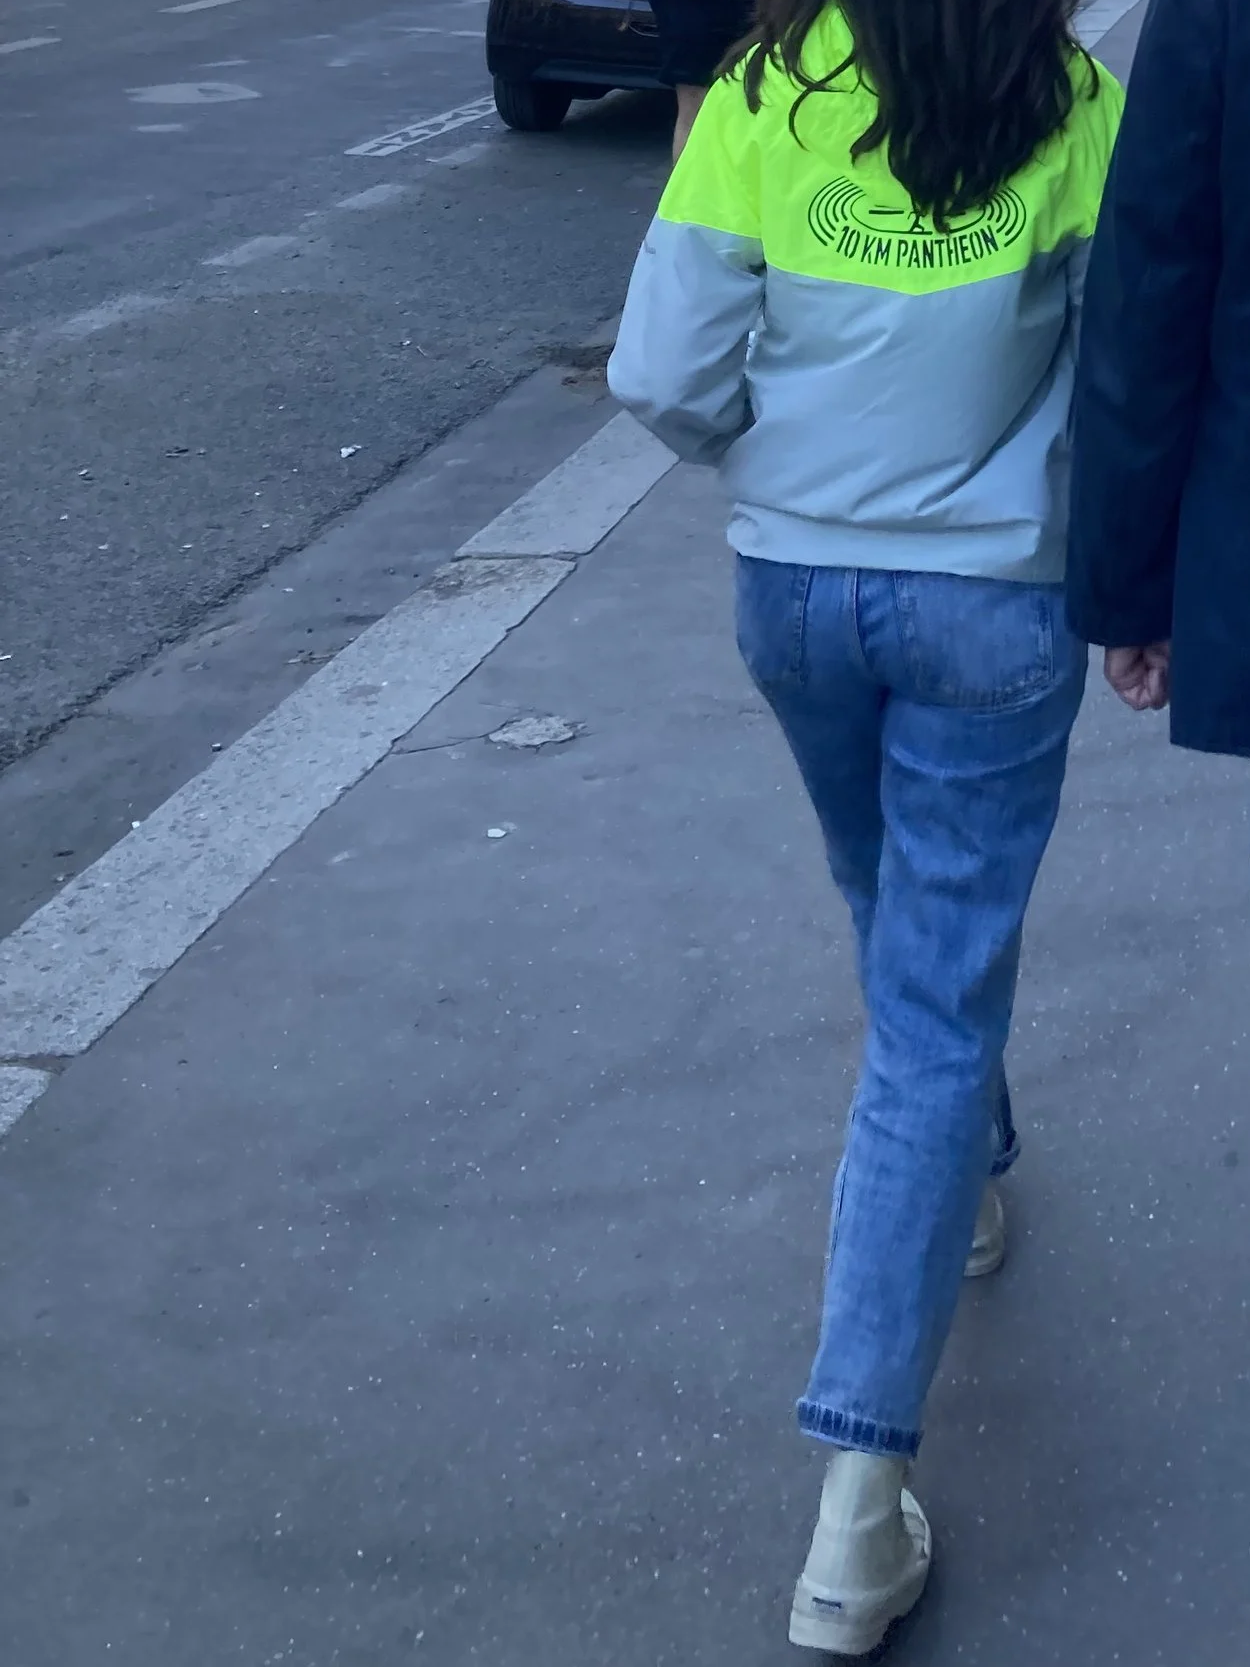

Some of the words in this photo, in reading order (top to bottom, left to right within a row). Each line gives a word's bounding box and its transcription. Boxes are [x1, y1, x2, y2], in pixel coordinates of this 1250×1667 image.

[836, 225, 861, 259] 10
[861, 234, 892, 266] KM
[896, 224, 999, 268] PANTHEON
